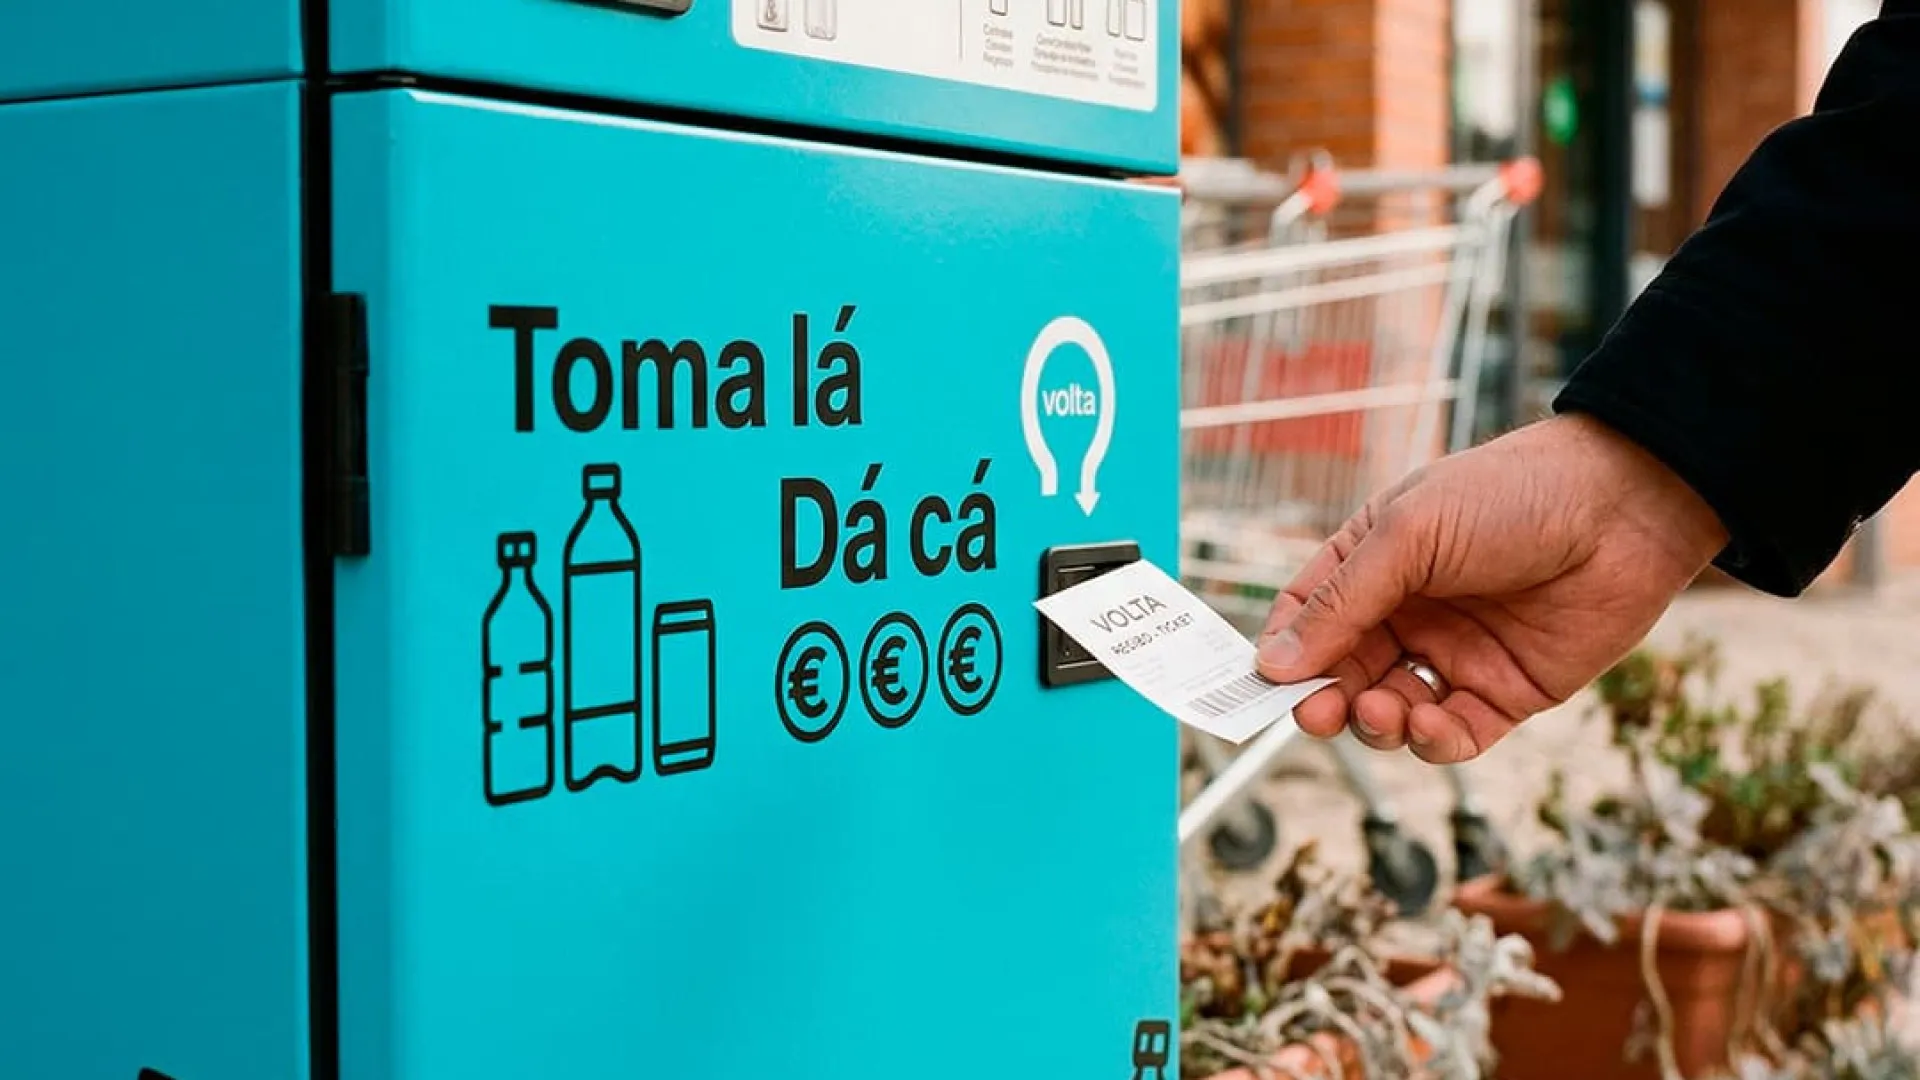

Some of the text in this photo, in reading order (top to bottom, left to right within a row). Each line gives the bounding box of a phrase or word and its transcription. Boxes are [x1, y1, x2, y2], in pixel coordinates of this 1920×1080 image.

[488, 305, 862, 432] Toma lá
[1042, 384, 1096, 417] volta
[780, 459, 997, 590] Dá cá
[1090, 594, 1168, 634] VOLTA
